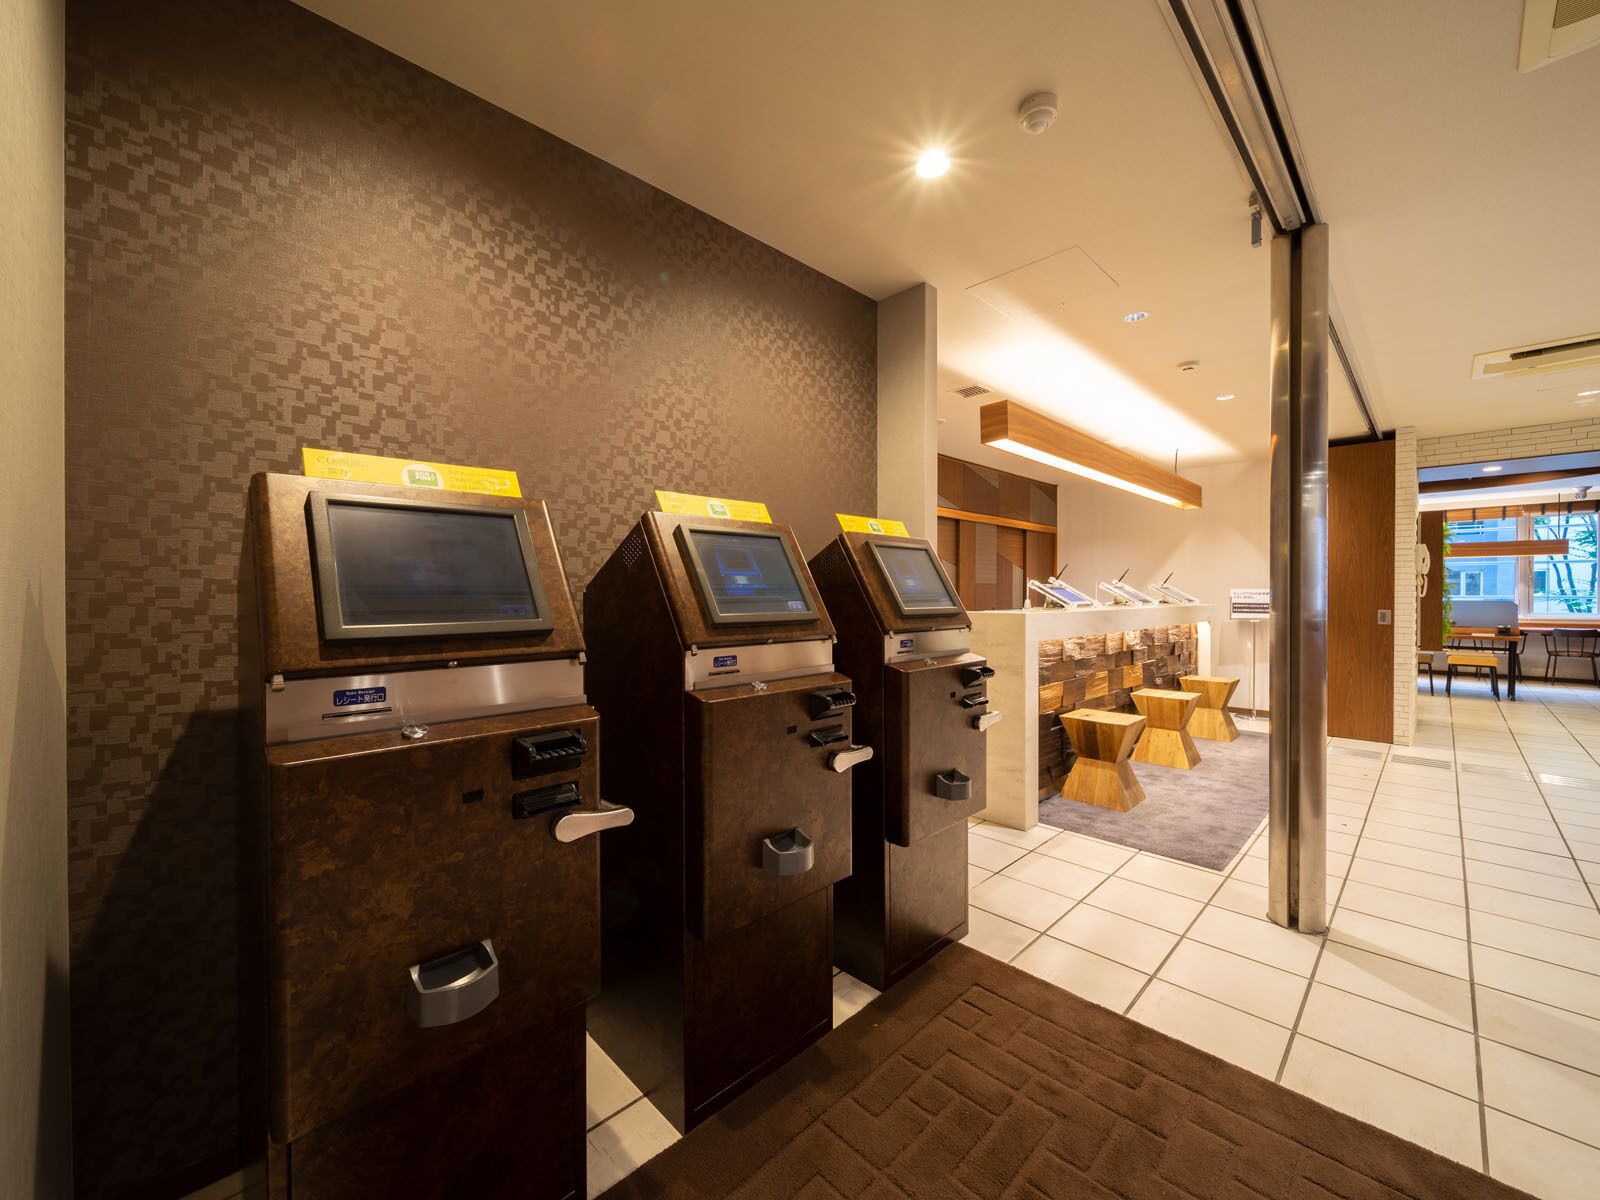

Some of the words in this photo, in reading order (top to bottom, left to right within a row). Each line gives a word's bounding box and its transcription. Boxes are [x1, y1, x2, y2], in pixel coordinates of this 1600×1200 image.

[336, 693, 384, 705] レシート発行口
